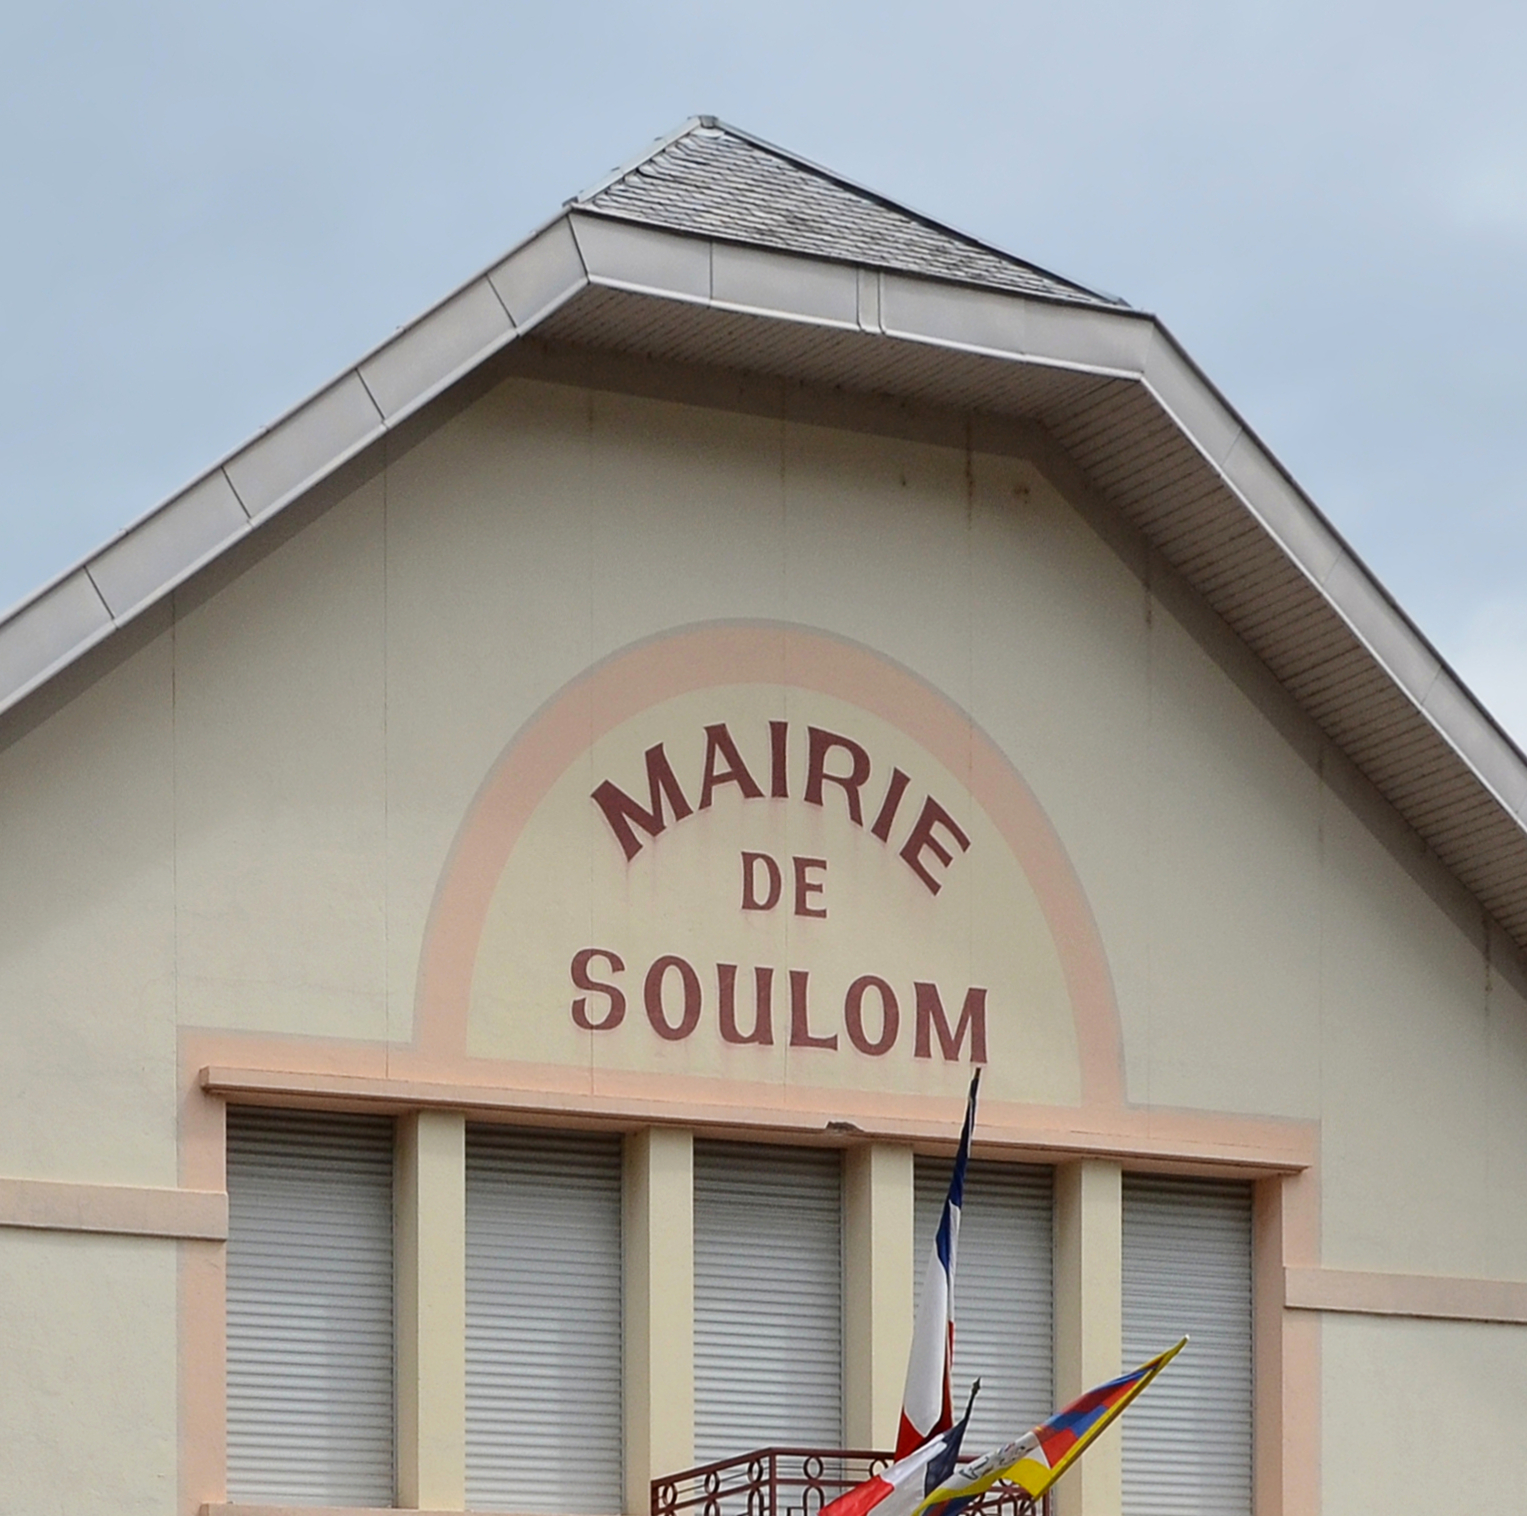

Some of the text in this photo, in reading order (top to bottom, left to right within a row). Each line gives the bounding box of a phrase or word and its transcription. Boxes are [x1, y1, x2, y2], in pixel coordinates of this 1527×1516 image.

[591, 720, 972, 897] MAIRIE
[741, 850, 828, 919] DE
[570, 948, 988, 1064] SOULOM
